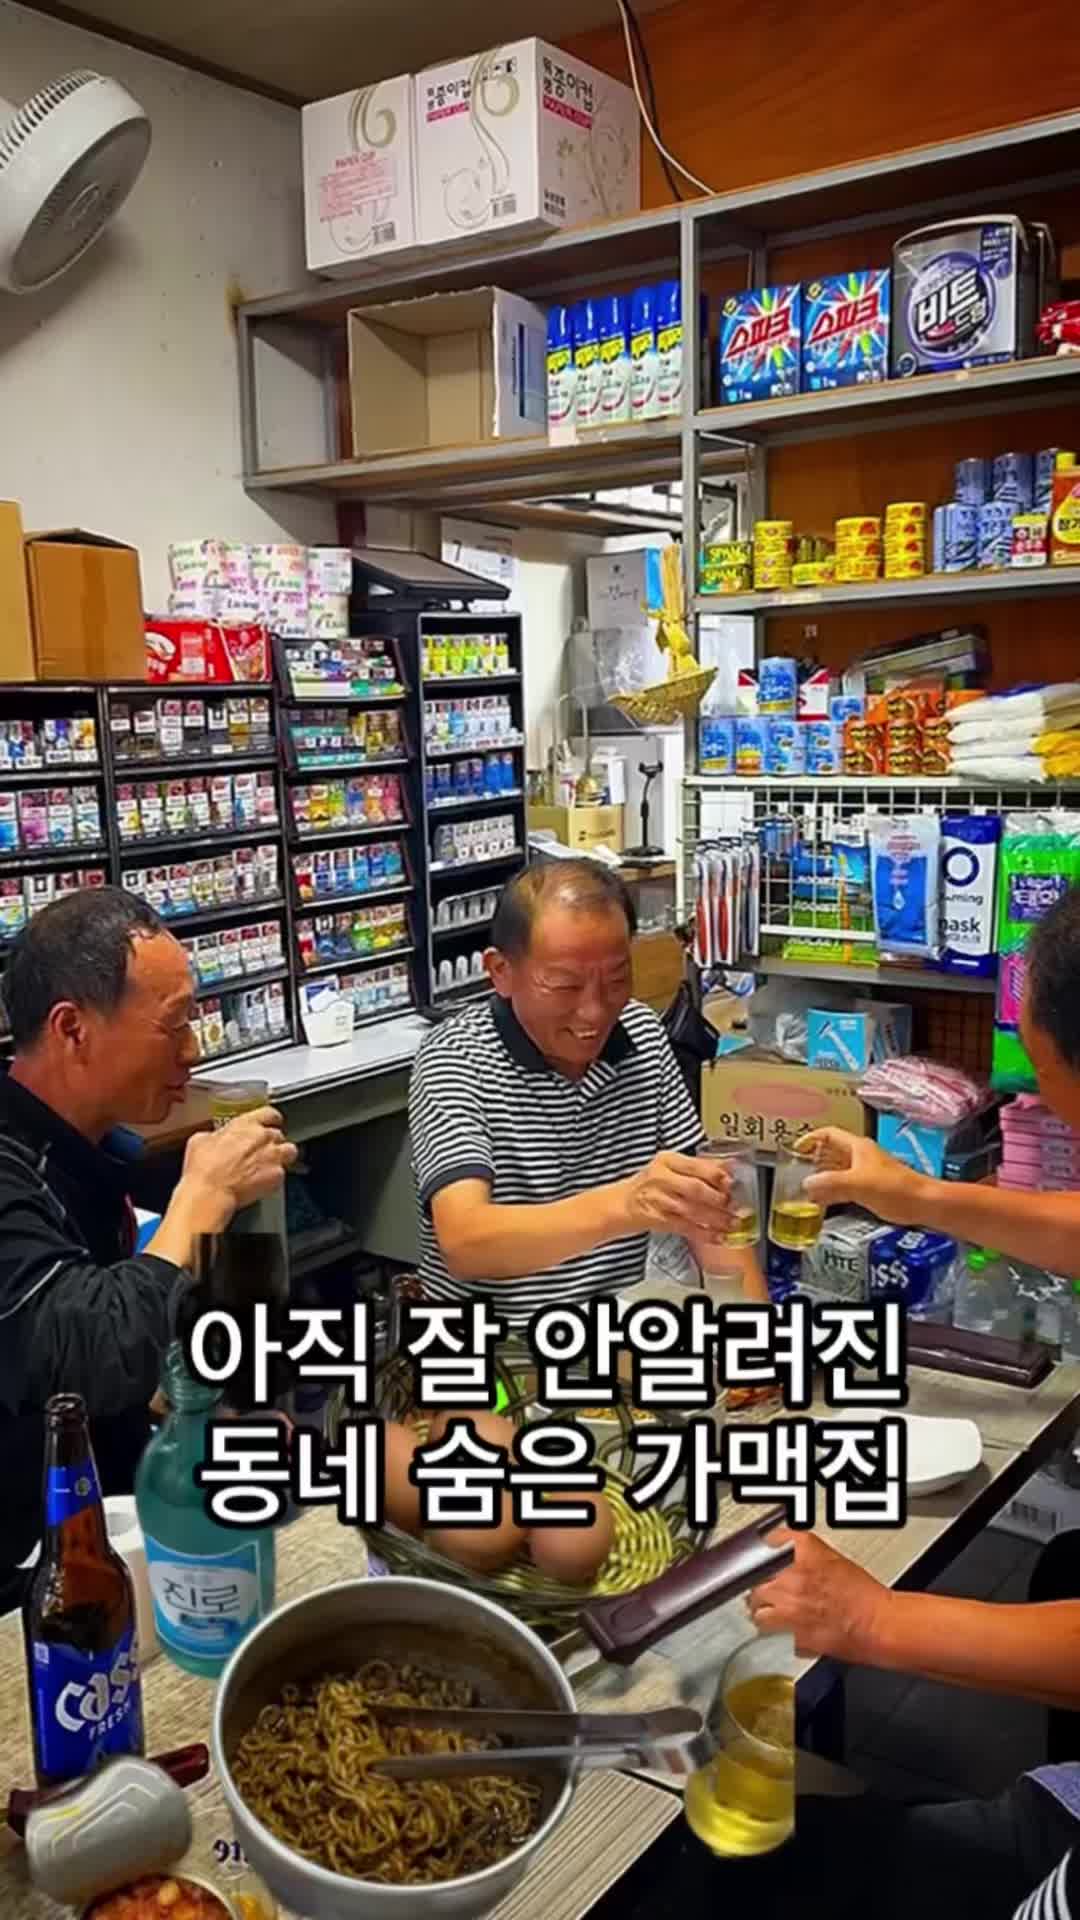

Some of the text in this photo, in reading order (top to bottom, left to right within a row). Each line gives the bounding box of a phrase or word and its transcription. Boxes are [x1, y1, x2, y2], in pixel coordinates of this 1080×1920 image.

[808, 291, 880, 345] 스파크
[918, 266, 980, 334] 비트
[725, 306, 791, 358] 스파크
[162, 1577, 241, 1615] 진로
